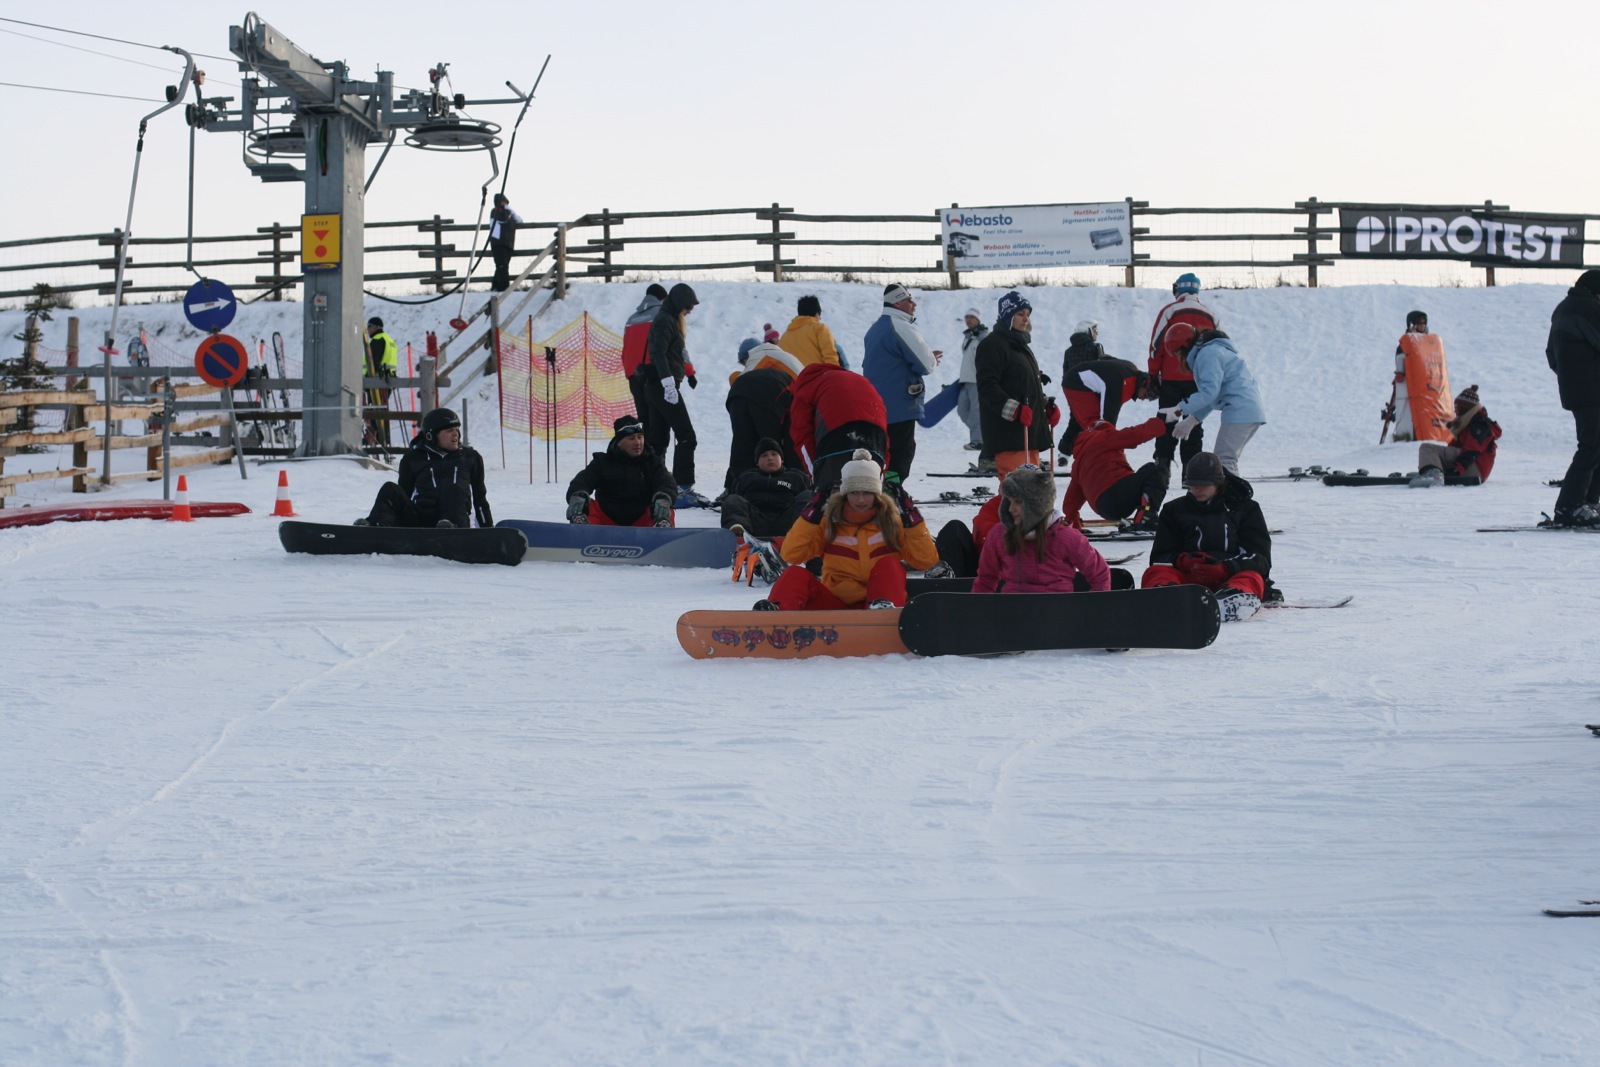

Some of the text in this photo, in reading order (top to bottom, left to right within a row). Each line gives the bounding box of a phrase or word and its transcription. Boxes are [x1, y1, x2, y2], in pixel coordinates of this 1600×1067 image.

[946, 213, 1013, 227] Webasto
[1396, 215, 1569, 261] PROTEST
[777, 480, 792, 490] NIKE
[589, 546, 637, 557] Oxygen
